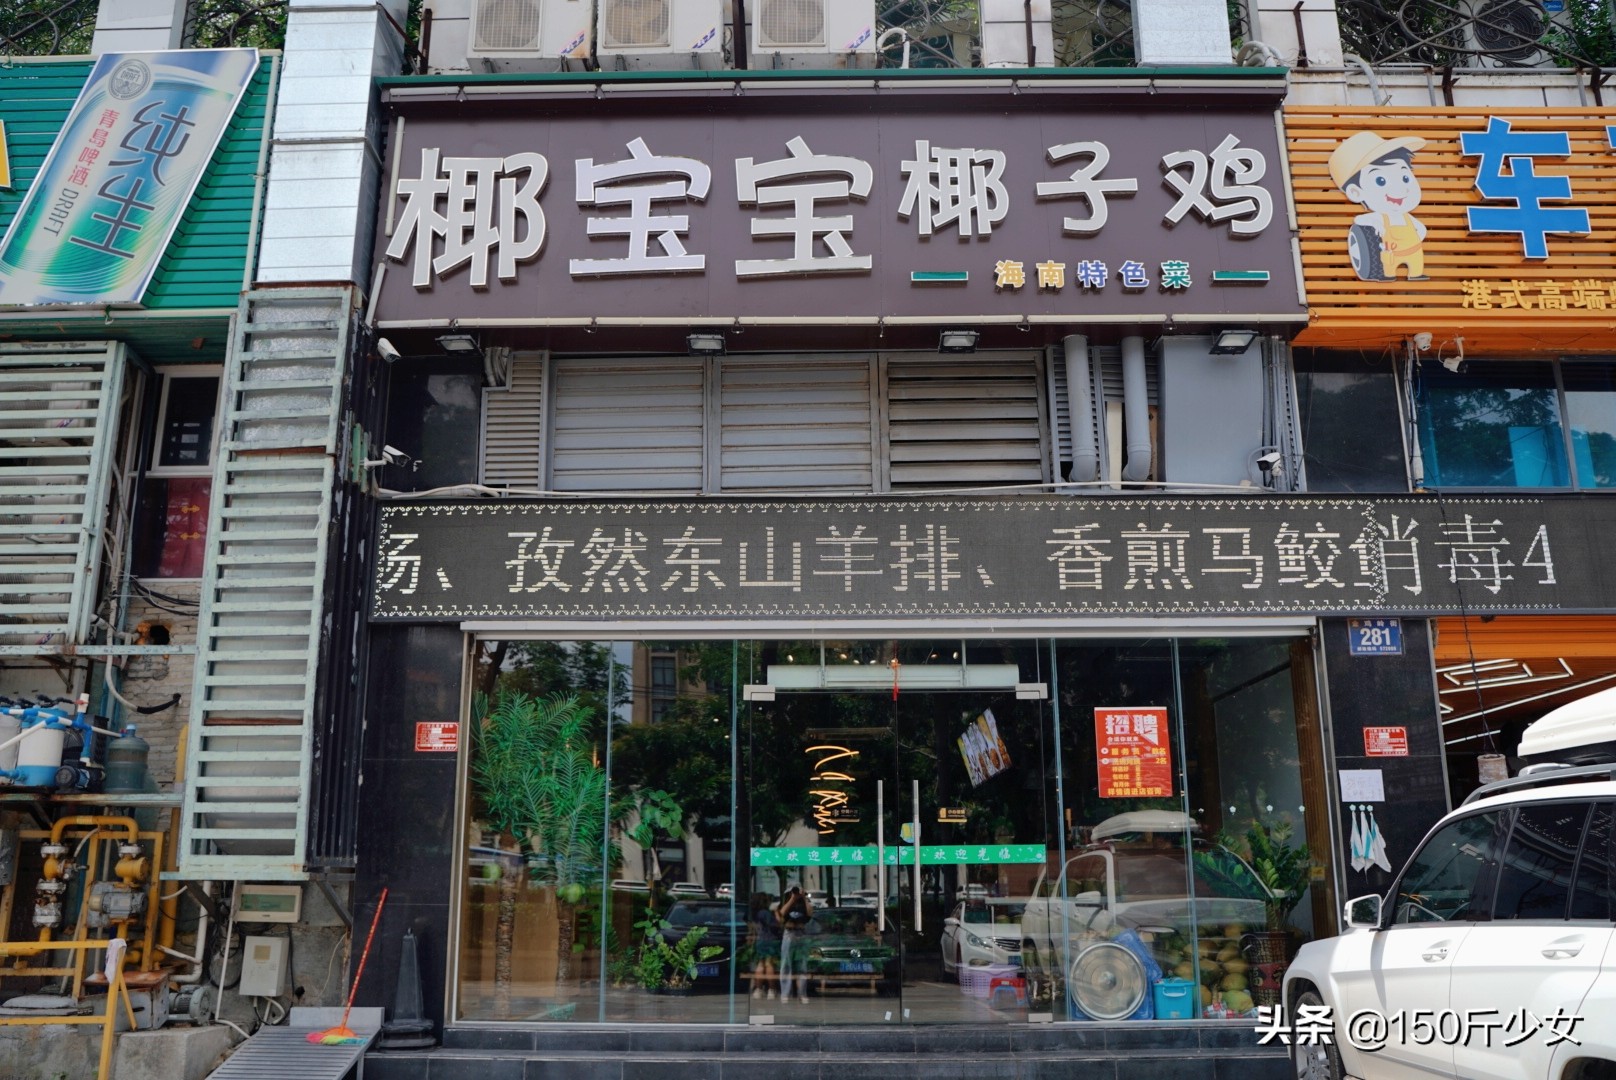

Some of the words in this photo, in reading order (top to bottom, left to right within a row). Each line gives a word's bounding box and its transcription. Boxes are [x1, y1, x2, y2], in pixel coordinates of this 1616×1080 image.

[70, 101, 196, 259] 纯生
[1460, 115, 1616, 259] 车
[43, 188, 79, 237] DRAFT
[386, 133, 1273, 288] 椰宝宝椰子鸡
[994, 260, 1193, 291] 海南特色菜
[1360, 628, 1391, 646] 281
[1105, 713, 1159, 746] 招聘
[786, 849, 864, 862] 欢迎光临
[933, 848, 1011, 861] 欢迎光临
